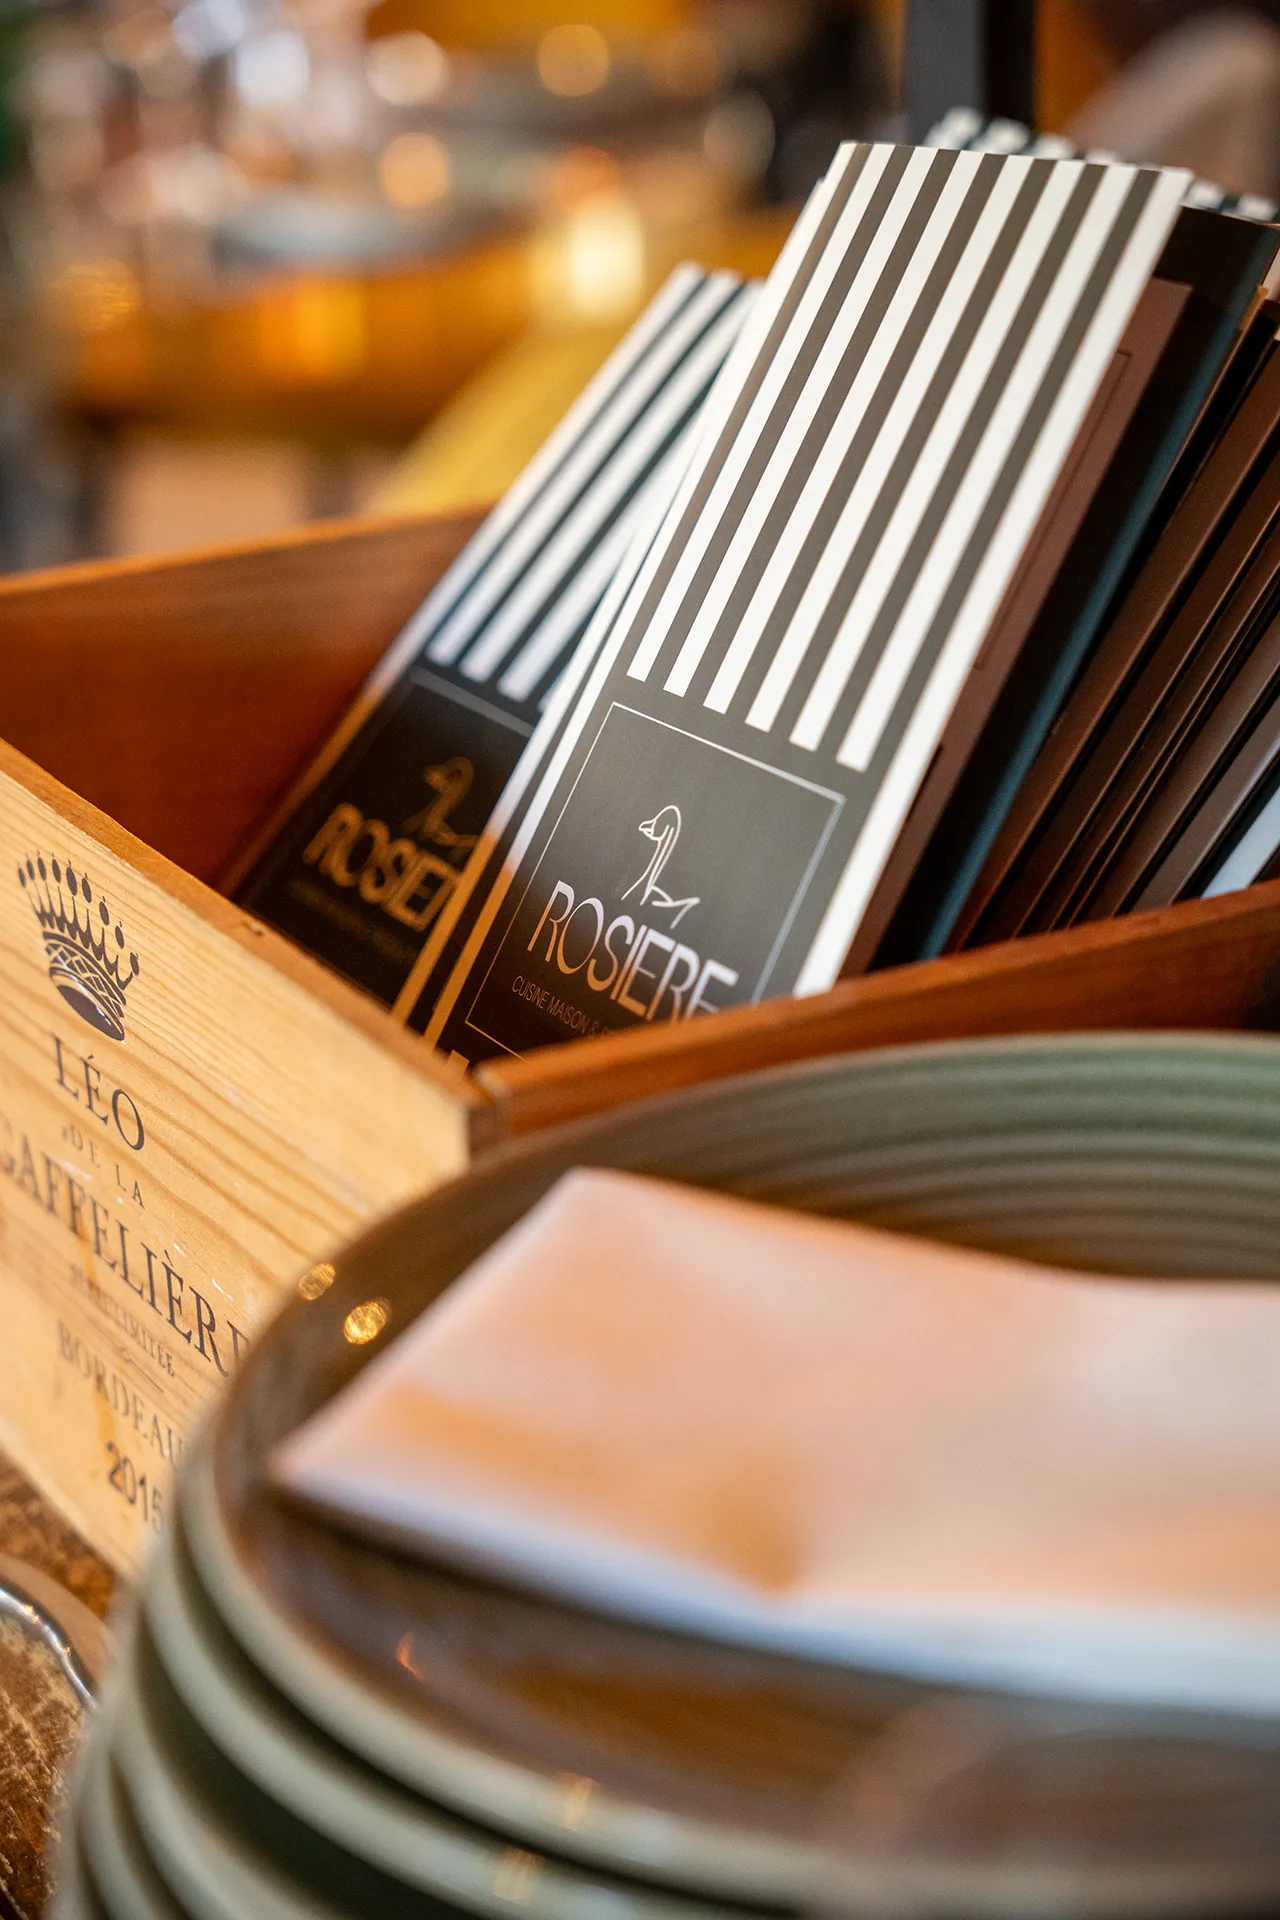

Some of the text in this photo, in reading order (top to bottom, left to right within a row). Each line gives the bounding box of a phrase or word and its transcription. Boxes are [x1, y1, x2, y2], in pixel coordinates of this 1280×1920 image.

[511, 975, 550, 1011] CUISINE
[546, 995, 591, 1034] MAISON
[52, 1033, 145, 1151] LÉO
[69, 1122, 145, 1209] DE LA
[107, 1440, 163, 1533] 2015
